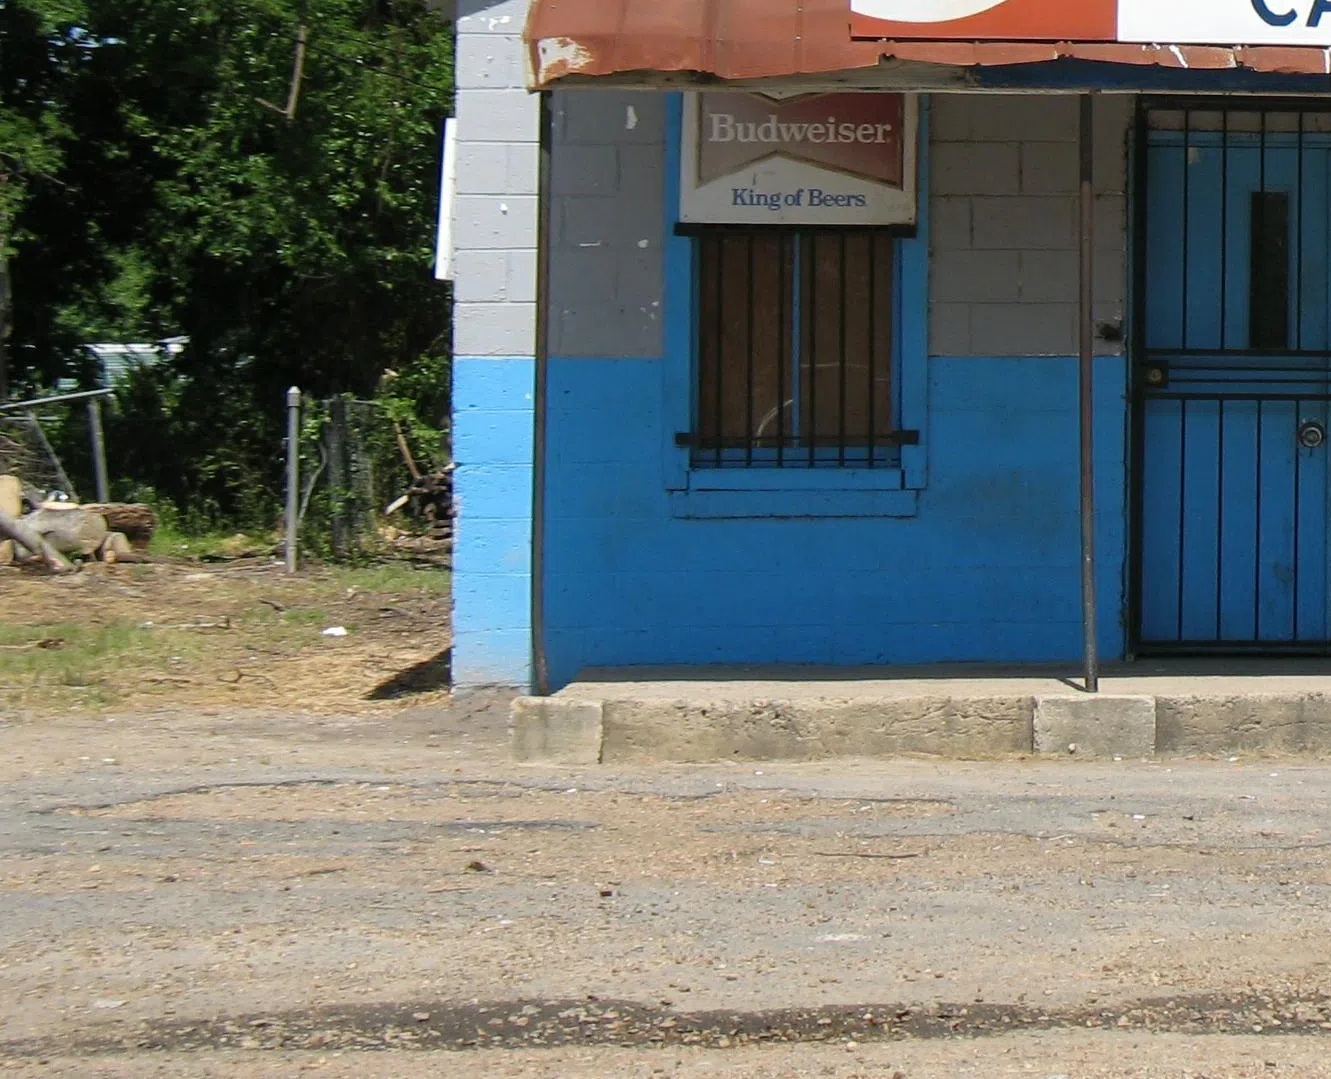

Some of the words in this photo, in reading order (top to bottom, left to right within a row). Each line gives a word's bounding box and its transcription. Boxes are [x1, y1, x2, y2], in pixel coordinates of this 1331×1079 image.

[708, 112, 892, 145] Budweiser
[731, 187, 781, 210] King
[783, 187, 805, 207] of
[807, 188, 867, 208] Beers
